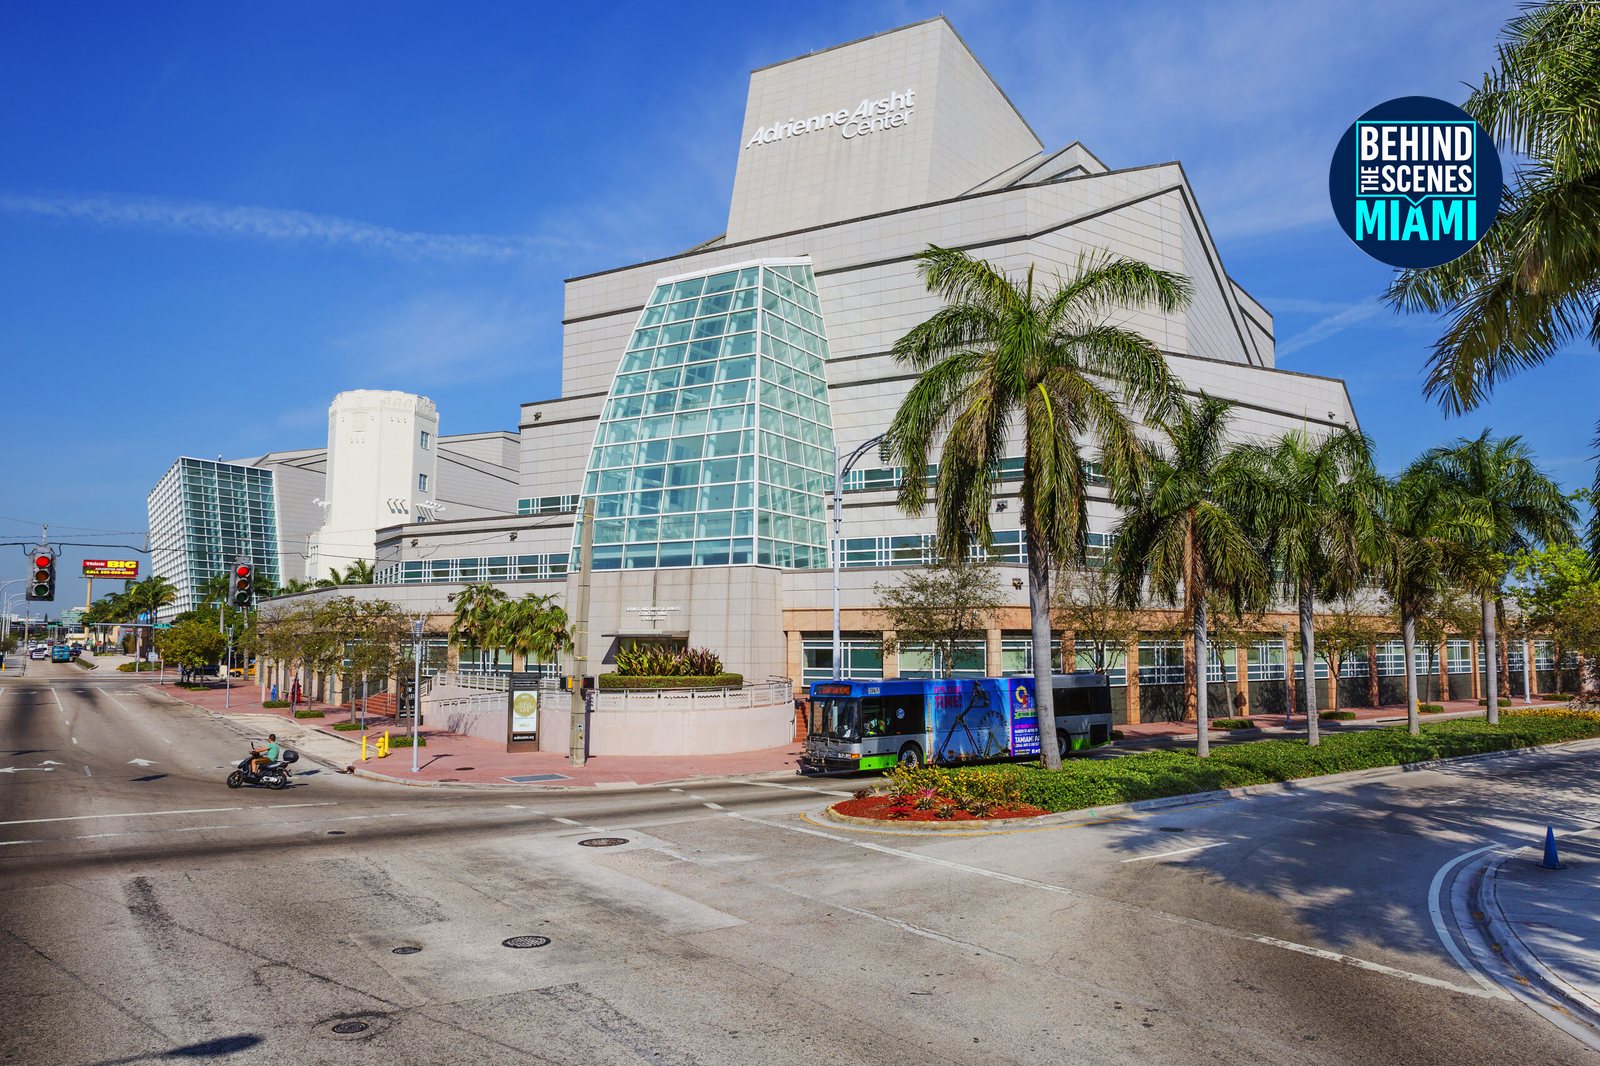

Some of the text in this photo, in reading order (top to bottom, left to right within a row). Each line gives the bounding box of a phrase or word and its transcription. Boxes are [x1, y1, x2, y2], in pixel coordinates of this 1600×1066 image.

[746, 88, 915, 149] Adrienne Arsht
[842, 109, 914, 139] Center
